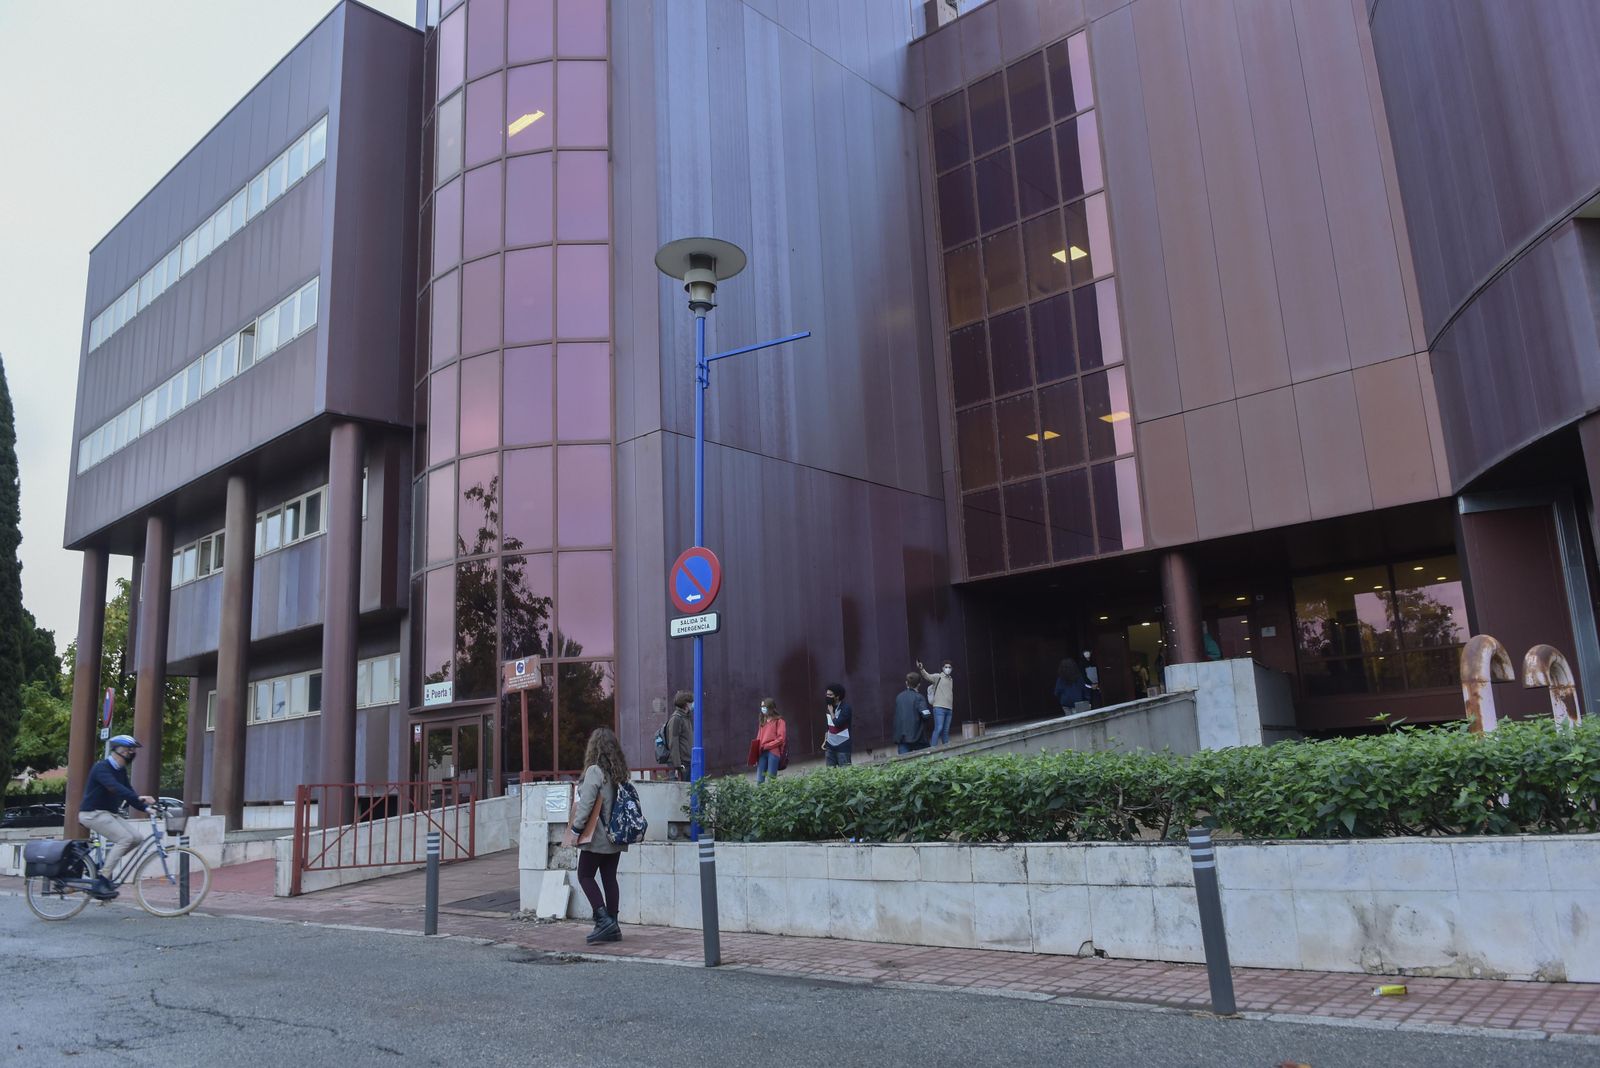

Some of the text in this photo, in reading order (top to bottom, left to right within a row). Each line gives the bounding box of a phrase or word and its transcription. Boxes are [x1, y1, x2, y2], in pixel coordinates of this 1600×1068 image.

[680, 618, 698, 626] SALIDA
[677, 624, 710, 633] EMERGENCIA
[431, 684, 448, 699] Puerta
